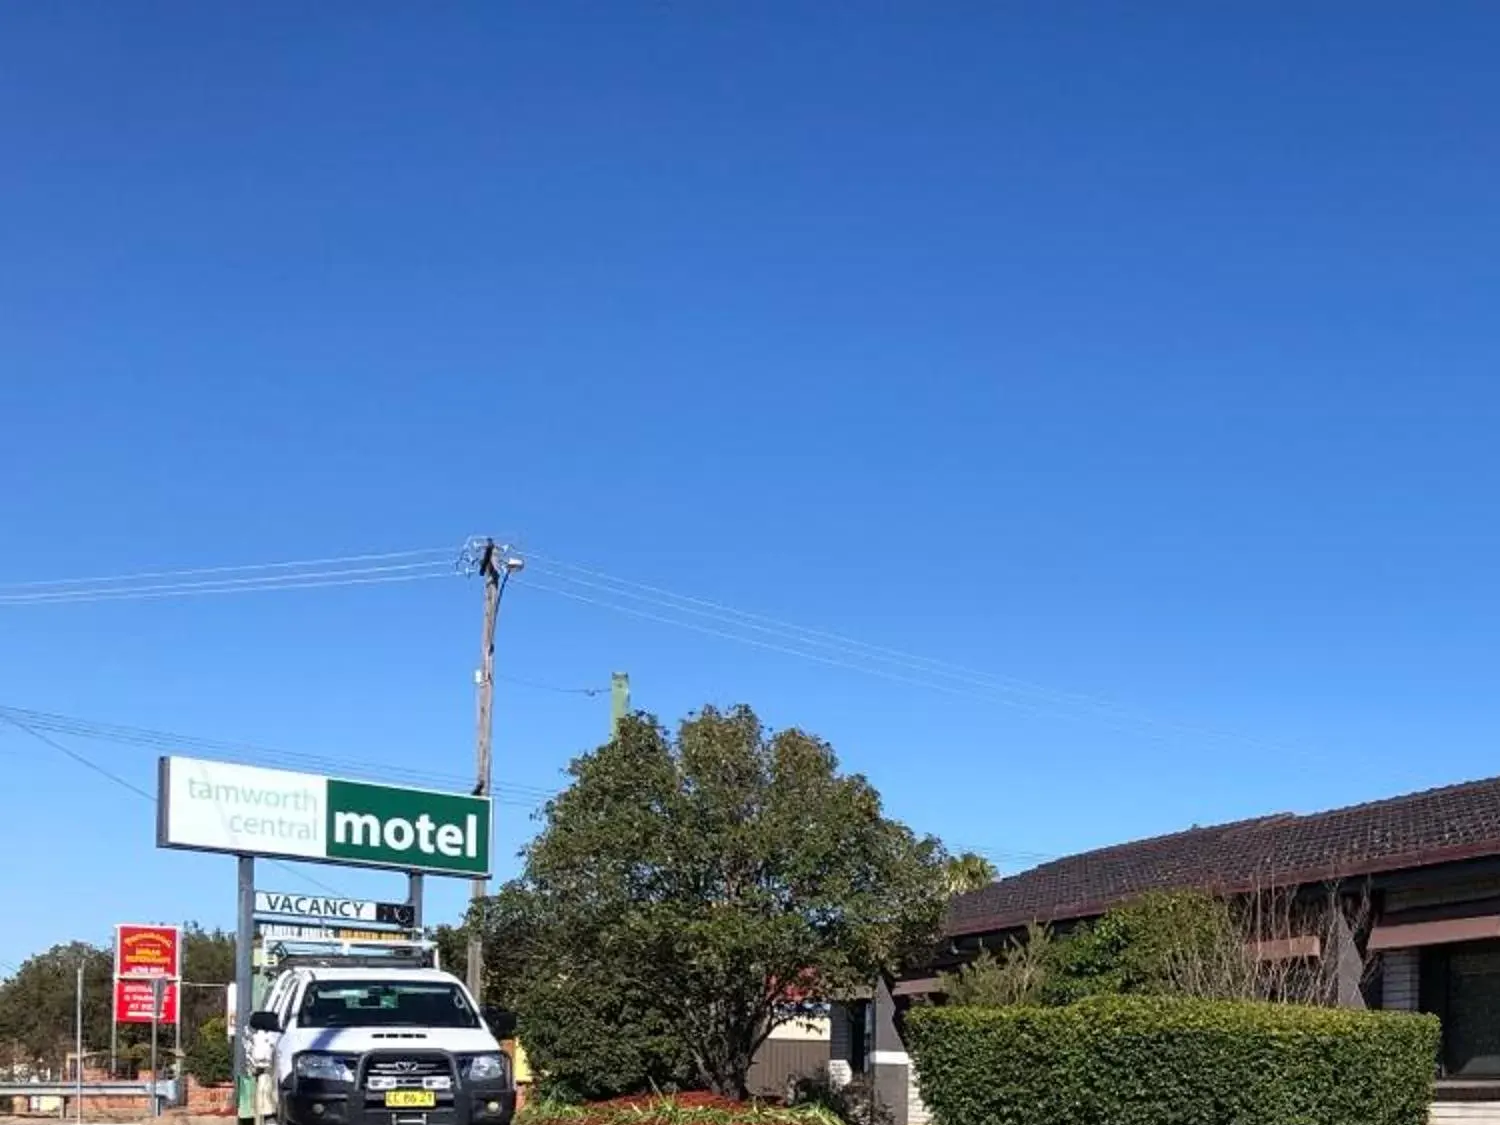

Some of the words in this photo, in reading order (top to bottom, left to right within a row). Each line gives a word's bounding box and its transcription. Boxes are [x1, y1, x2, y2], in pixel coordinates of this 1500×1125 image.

[188, 776, 318, 813] tamworth
[229, 813, 318, 842] central
[334, 811, 477, 858] motel
[266, 895, 365, 918] VACANCY
